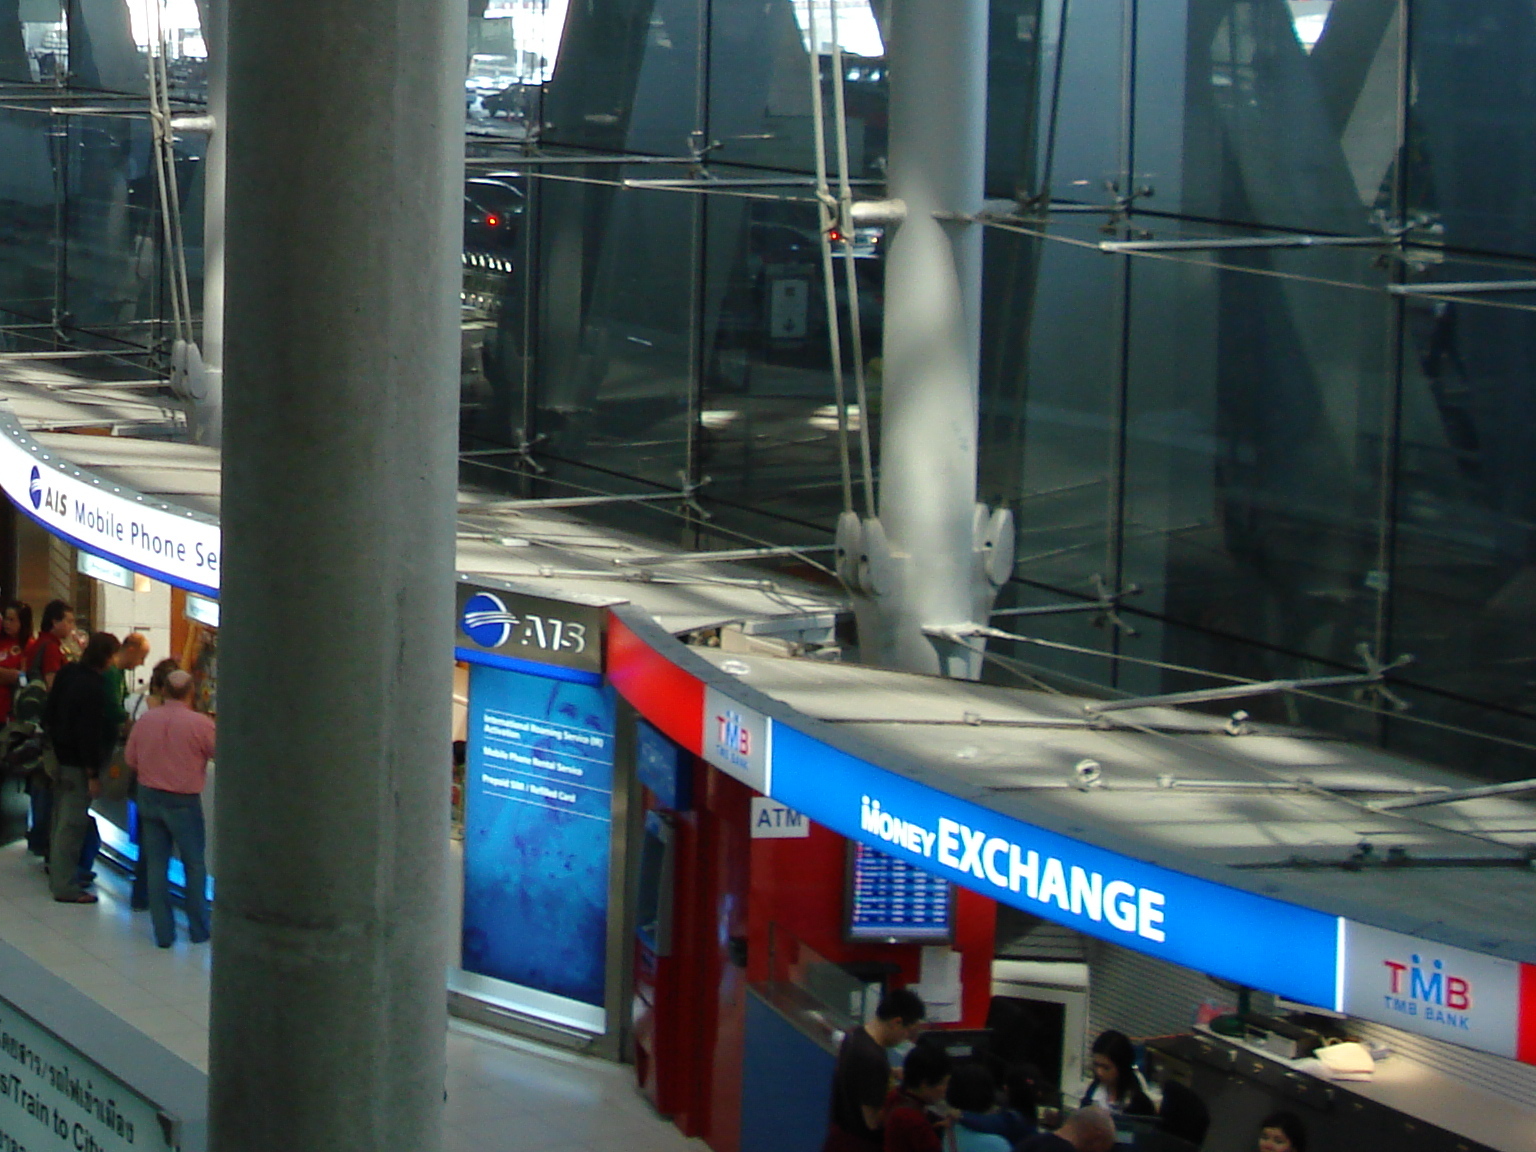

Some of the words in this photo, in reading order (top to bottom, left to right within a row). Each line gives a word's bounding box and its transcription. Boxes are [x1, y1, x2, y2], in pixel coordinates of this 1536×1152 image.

[45, 486, 67, 517] AIS
[75, 499, 124, 541] Mobile
[131, 521, 186, 562] Phone
[563, 731, 590, 745] Service
[716, 710, 751, 756] TMB
[483, 746, 509, 760] Mobile
[509, 752, 532, 765] Phone
[557, 762, 583, 777] Service
[559, 791, 576, 803] Card
[757, 808, 802, 828] ATM
[861, 795, 936, 858] MONEY
[938, 816, 1166, 943] EXCHANGE
[1383, 954, 1470, 1011] TMB
[1384, 995, 1418, 1016] TMB
[1425, 1007, 1470, 1031] BANK
[53, 1108, 68, 1140] to
